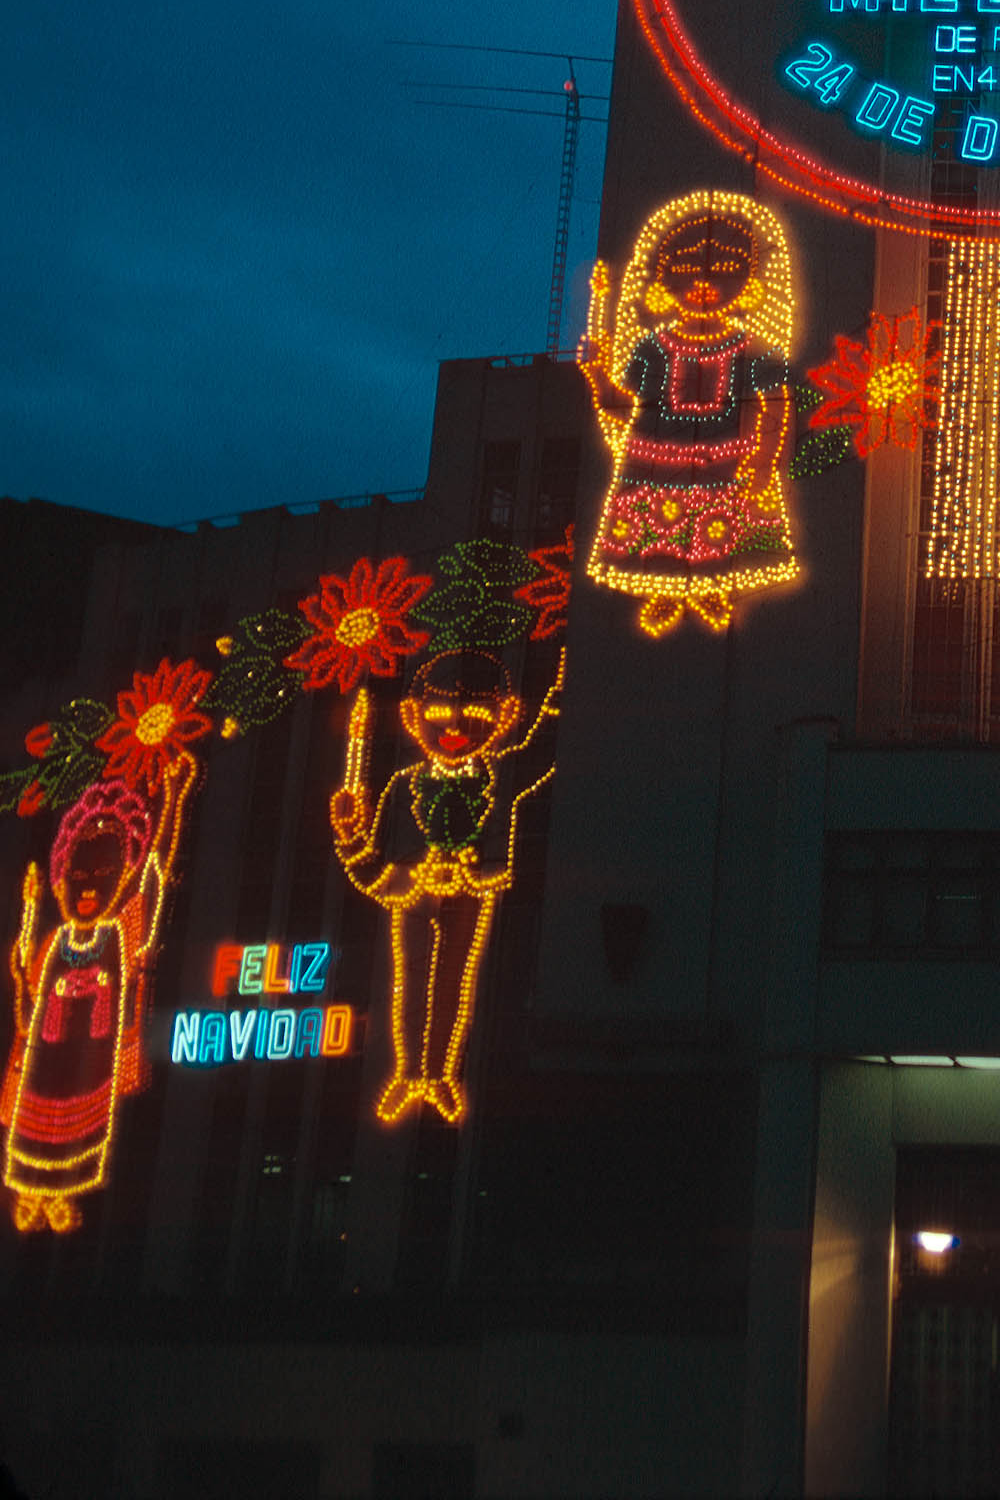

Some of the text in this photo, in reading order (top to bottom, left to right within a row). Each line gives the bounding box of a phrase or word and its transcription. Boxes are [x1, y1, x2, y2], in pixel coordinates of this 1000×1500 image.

[935, 25, 977, 54] DE
[784, 42, 854, 104] 24
[855, 82, 935, 145] DE
[211, 942, 330, 997] FELIZ
[171, 1003, 354, 1064] NAVIDAD
